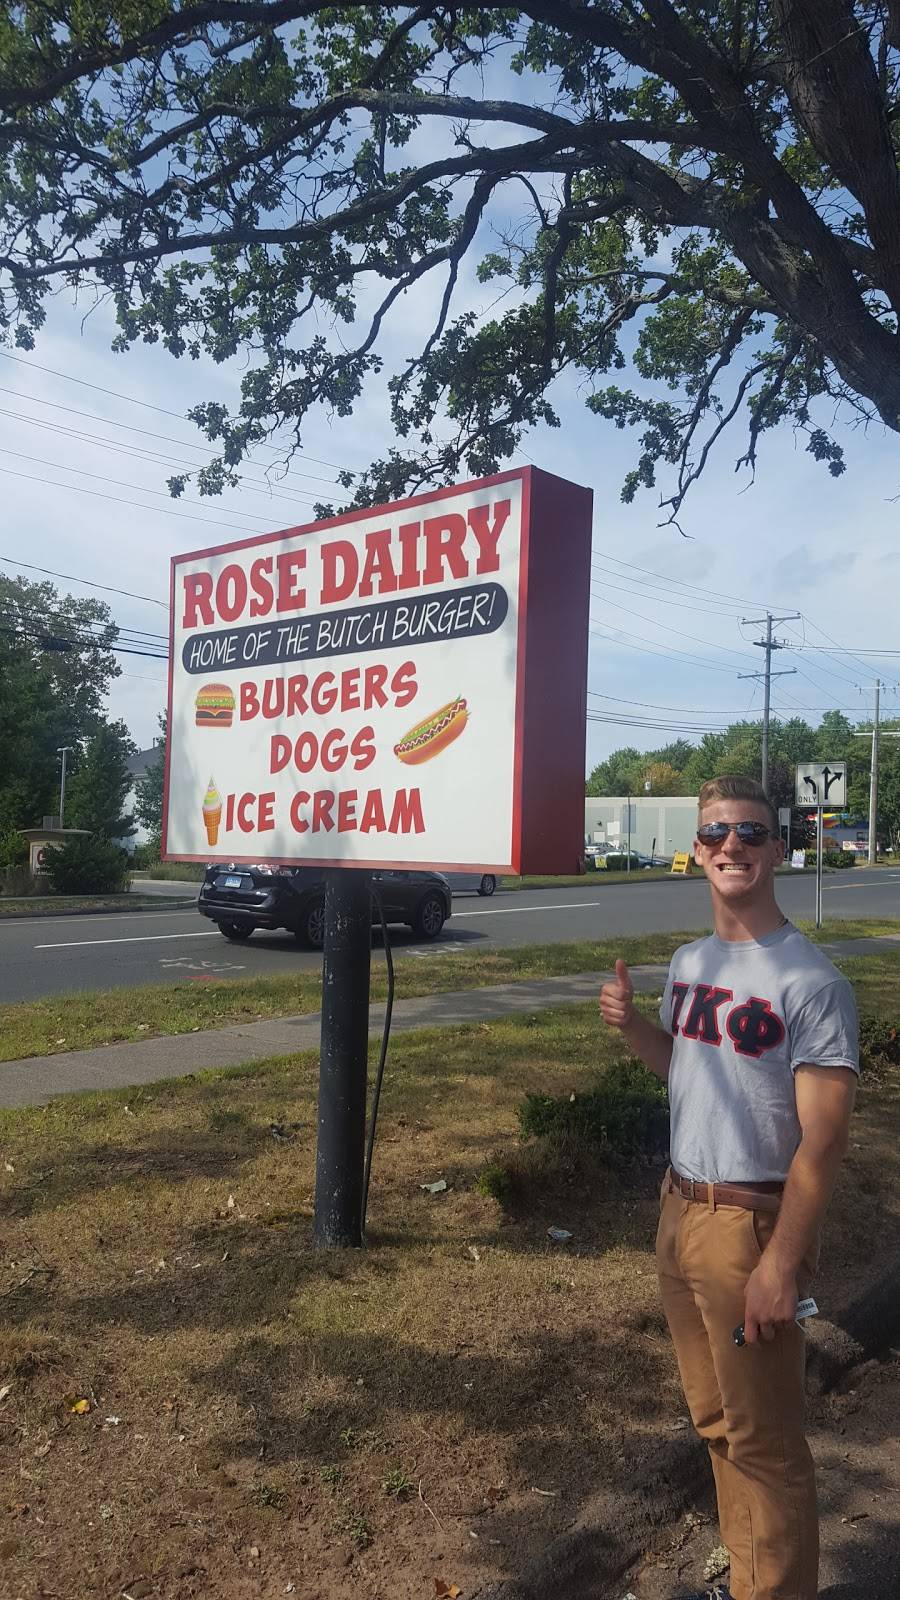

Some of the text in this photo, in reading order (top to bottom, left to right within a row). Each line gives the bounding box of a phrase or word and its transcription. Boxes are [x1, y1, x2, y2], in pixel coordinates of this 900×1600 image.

[182, 498, 511, 629] ROSE DAIRY
[190, 591, 498, 669] HOME OF THE BUTCH BURGER!
[239, 661, 418, 721] BURGERS
[270, 725, 376, 775] DOGS
[225, 787, 426, 834] ICE CREAM
[798, 795, 817, 804] ONLY
